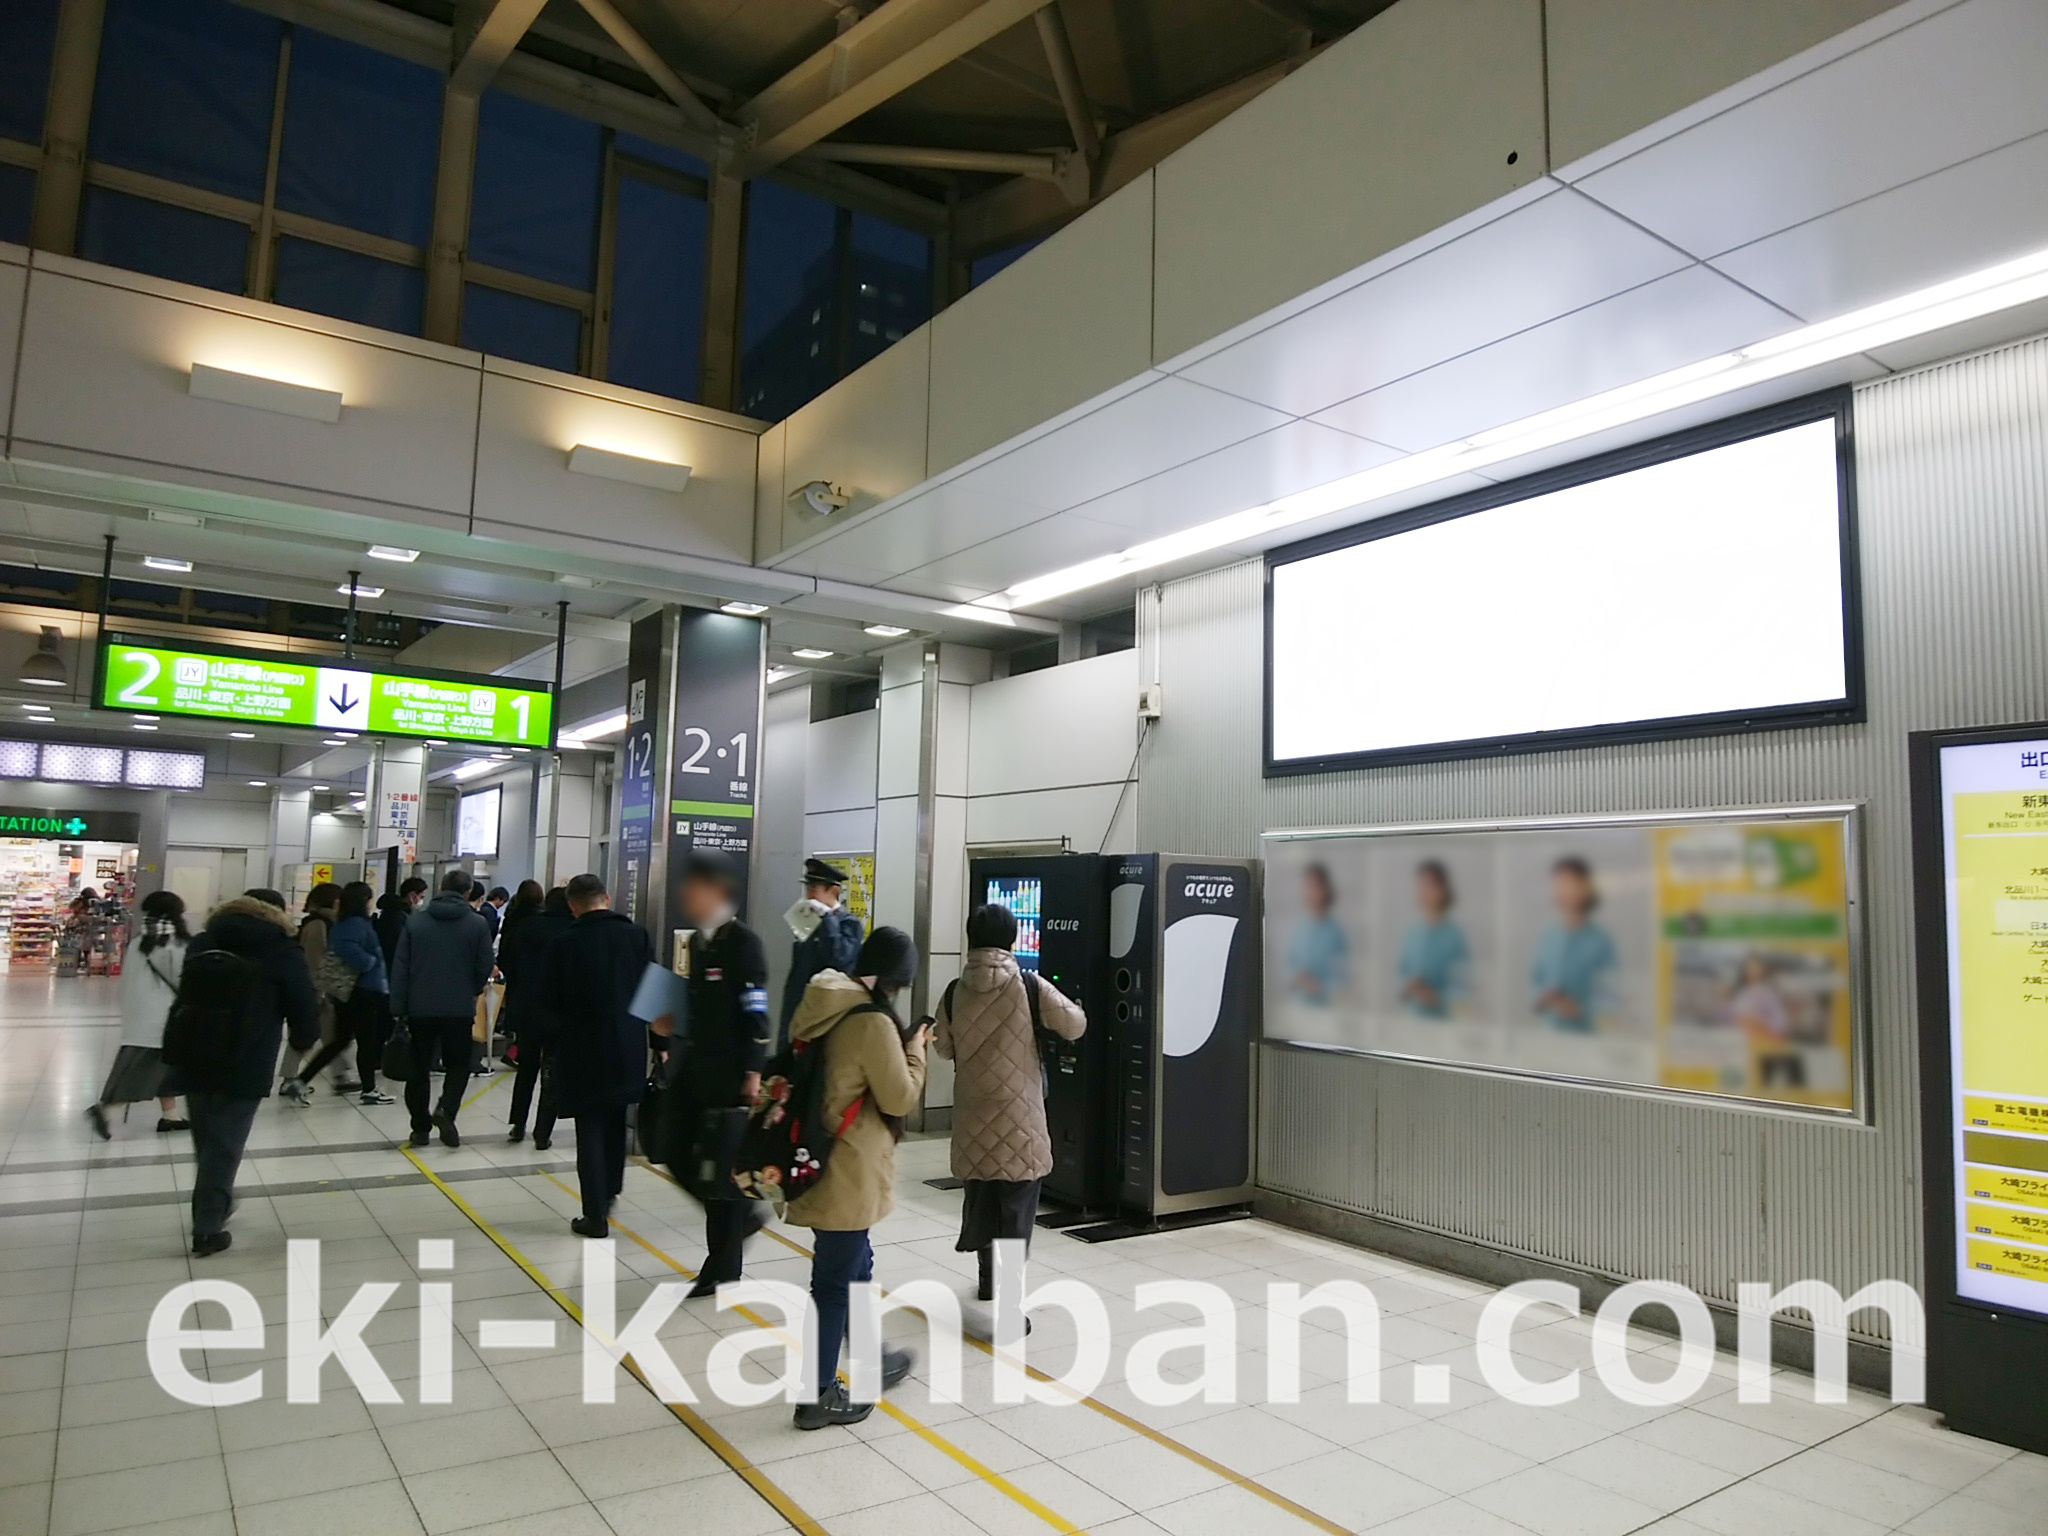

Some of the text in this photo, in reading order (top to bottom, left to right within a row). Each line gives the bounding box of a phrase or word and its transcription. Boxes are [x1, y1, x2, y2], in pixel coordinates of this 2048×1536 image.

[184, 667, 200, 677] JY
[119, 652, 161, 705] 2
[211, 679, 284, 695] Yamanote Line
[401, 698, 466, 713] Yamanote Line
[476, 698, 489, 707] JY
[256, 707, 263, 715] &
[263, 708, 284, 717] Ueno
[510, 695, 530, 739] 1
[469, 727, 475, 735] &
[475, 728, 493, 737] Ueno
[729, 781, 748, 792] 番線
[678, 824, 688, 832] JY
[1119, 865, 1143, 875] acure
[1184, 882, 1235, 898] acure
[1047, 918, 1079, 931] acure
